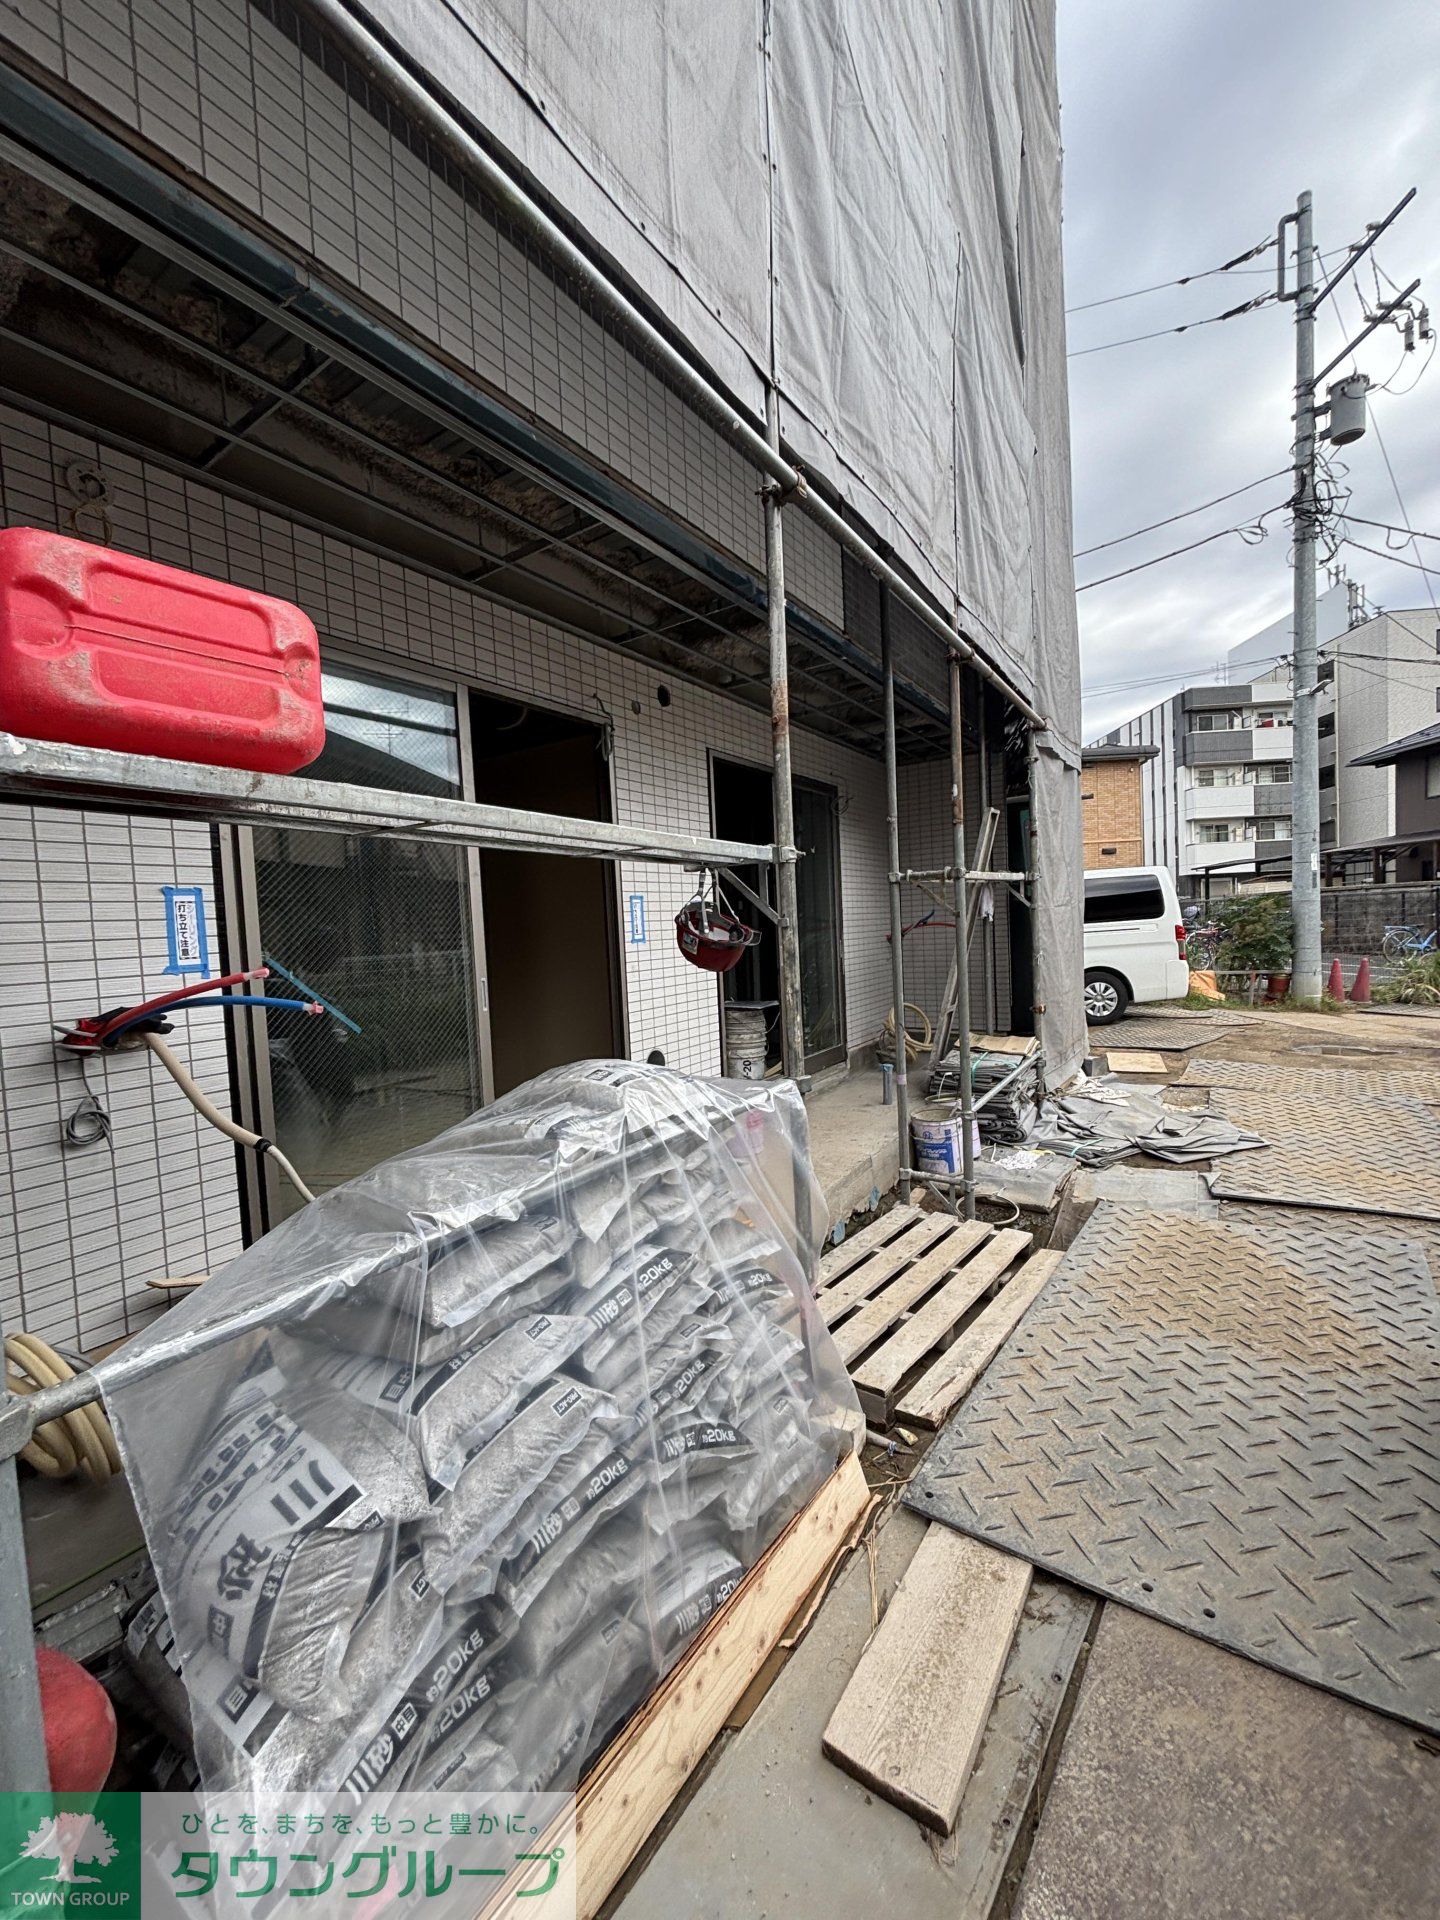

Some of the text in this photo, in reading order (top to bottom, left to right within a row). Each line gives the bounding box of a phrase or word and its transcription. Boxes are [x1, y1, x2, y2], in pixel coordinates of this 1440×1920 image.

[178, 904, 189, 957] 打ち立て注意
[591, 1299, 619, 1329] 川砂
[556, 1389, 580, 1414] PRO-ACT
